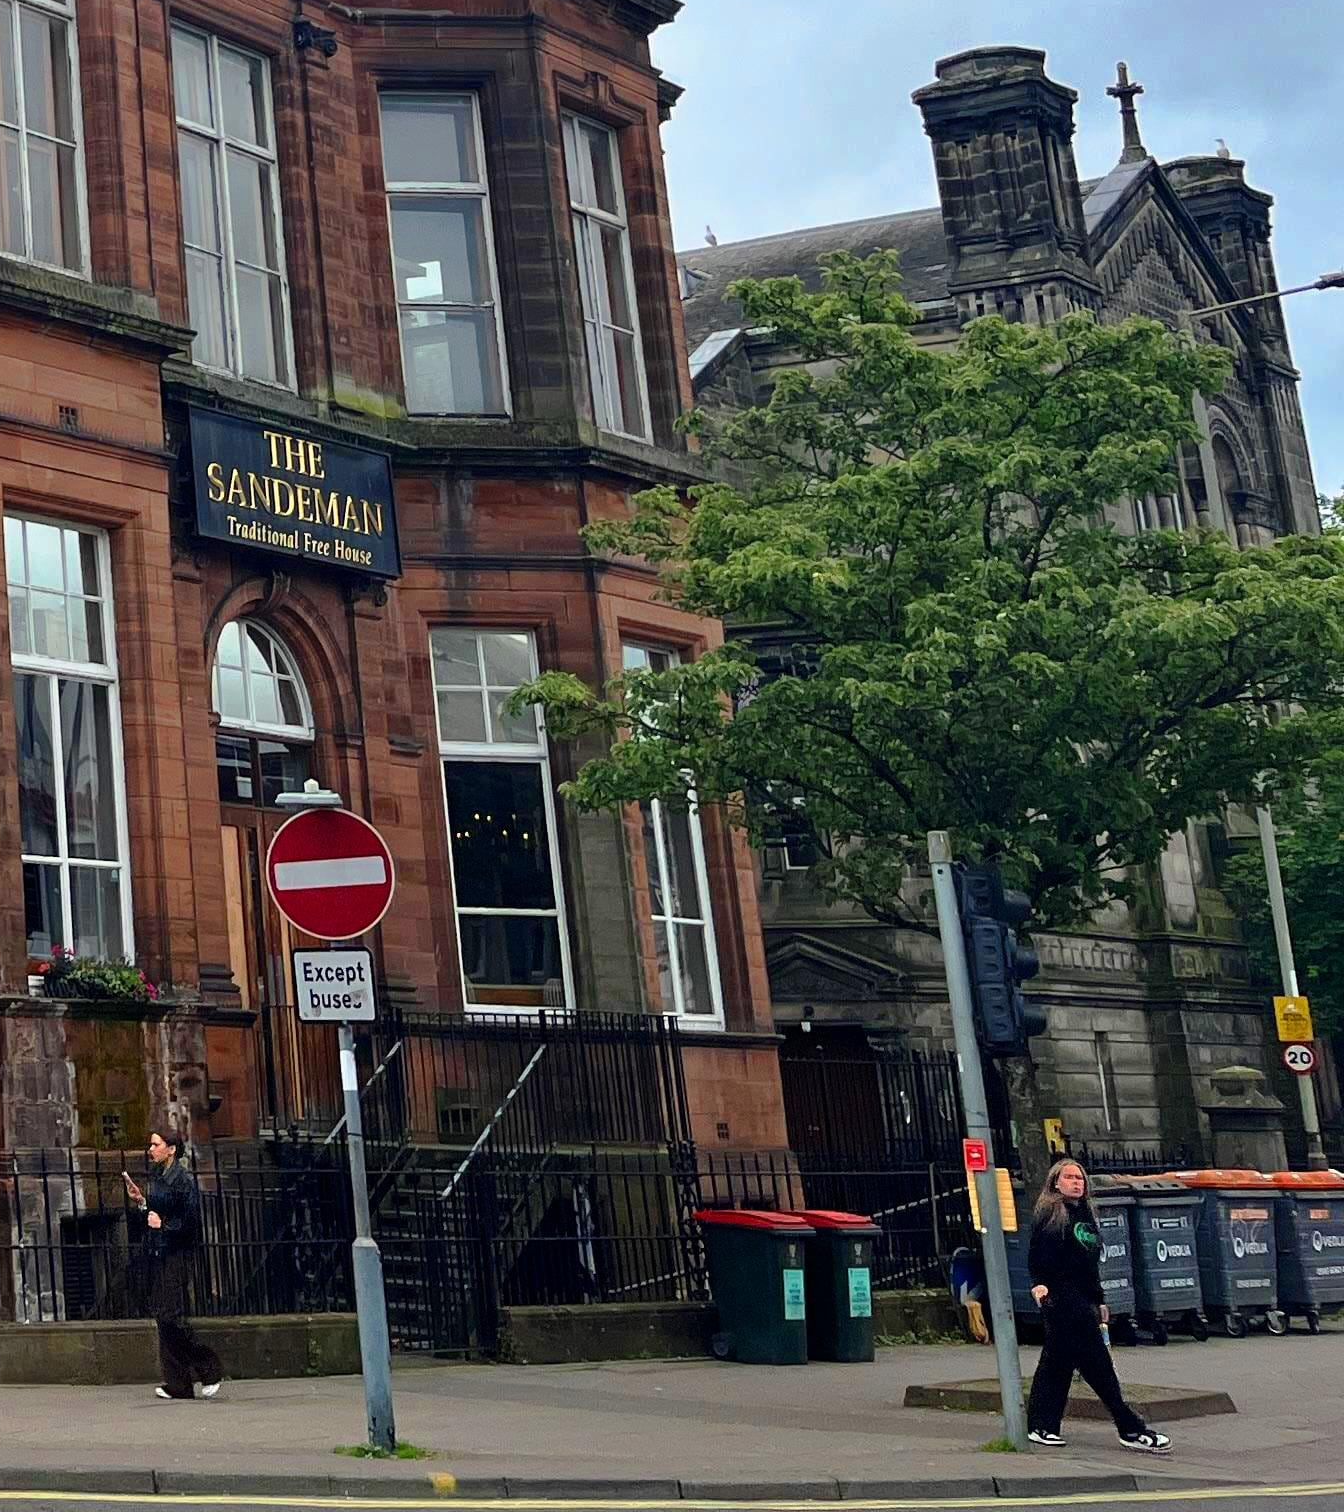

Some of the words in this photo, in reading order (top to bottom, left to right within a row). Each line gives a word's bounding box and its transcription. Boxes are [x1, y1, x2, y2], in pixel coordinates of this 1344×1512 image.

[263, 430, 325, 479] THE
[207, 462, 383, 537] SANDEMAN
[227, 515, 299, 549] Traditional
[304, 532, 330, 556] Free
[334, 539, 372, 565] House
[303, 961, 365, 986] Except
[1288, 1051, 1312, 1065] 20
